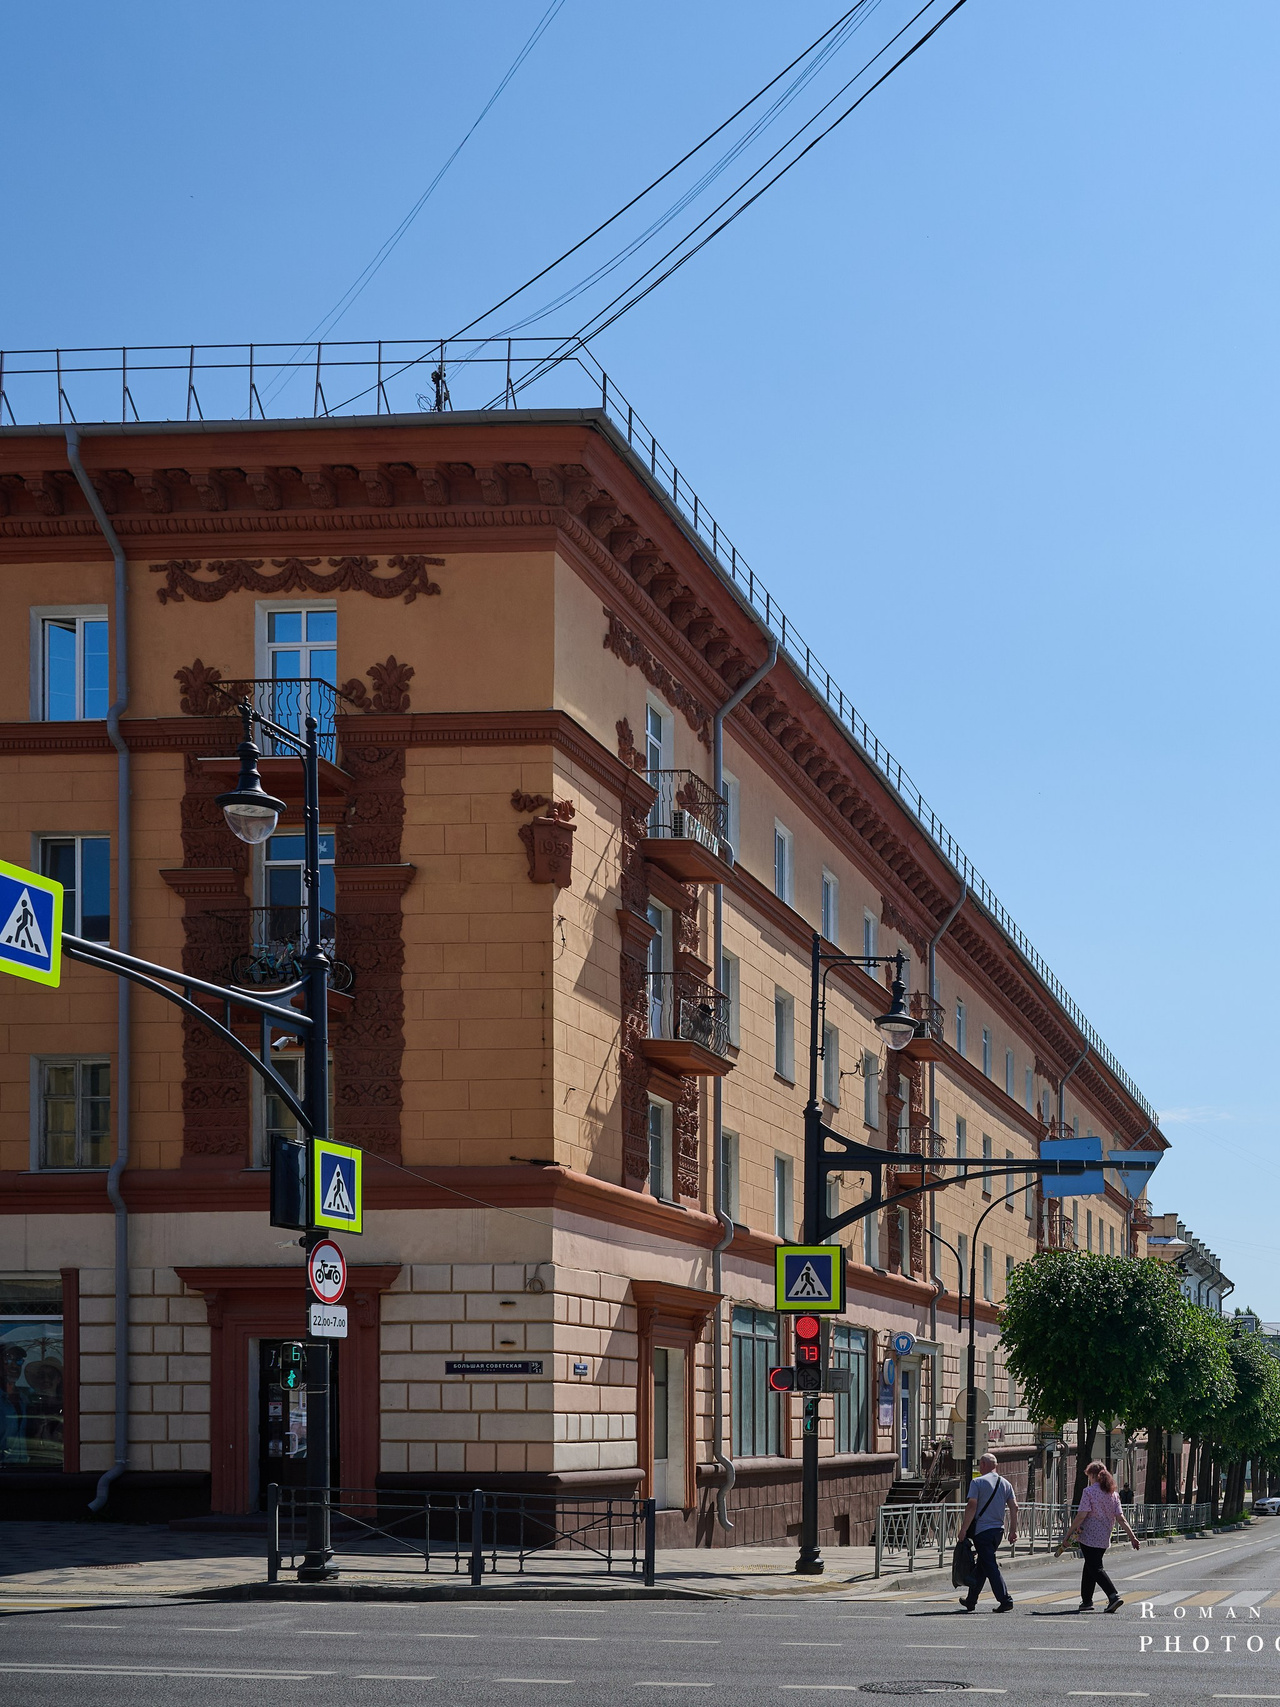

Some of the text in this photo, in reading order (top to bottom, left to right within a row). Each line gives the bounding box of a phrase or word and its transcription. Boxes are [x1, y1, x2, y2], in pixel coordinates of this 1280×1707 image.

[540, 840, 571, 858] 1952
[313, 1315, 345, 1327] 22.00-7.00
[292, 1346, 300, 1360] 6
[800, 1346, 818, 1361] 73
